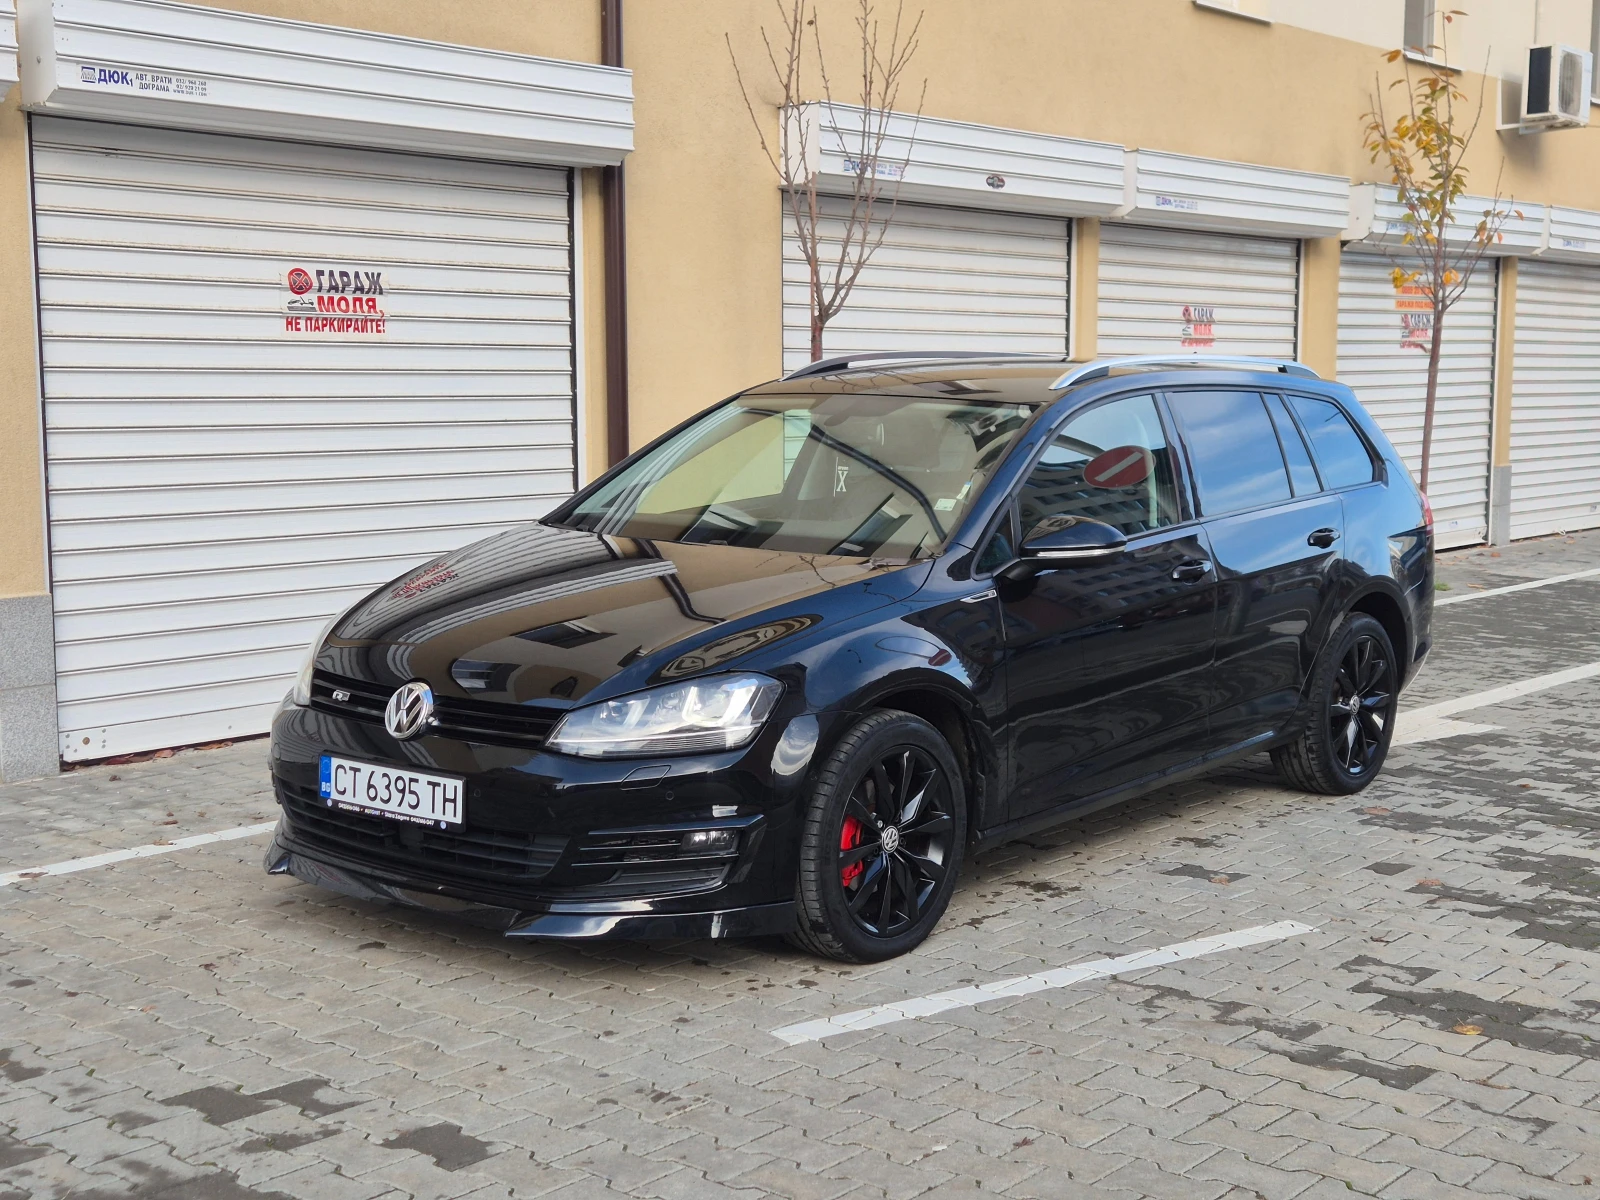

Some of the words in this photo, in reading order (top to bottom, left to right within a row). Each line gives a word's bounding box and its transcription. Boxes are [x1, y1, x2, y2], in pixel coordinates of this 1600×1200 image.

[139, 82, 170, 92] ДОГРАМА
[151, 75, 172, 84] ВРАТИ
[315, 270, 384, 295] ГАРАЖ
[317, 295, 385, 318] МОЛЯ,
[285, 316, 302, 332] НЕ
[305, 315, 386, 334] ПАРКИРАЙТЕ!
[321, 781, 331, 793] BG
[334, 764, 361, 798] CT
[367, 770, 420, 810] 6395
[427, 781, 457, 818] TH
